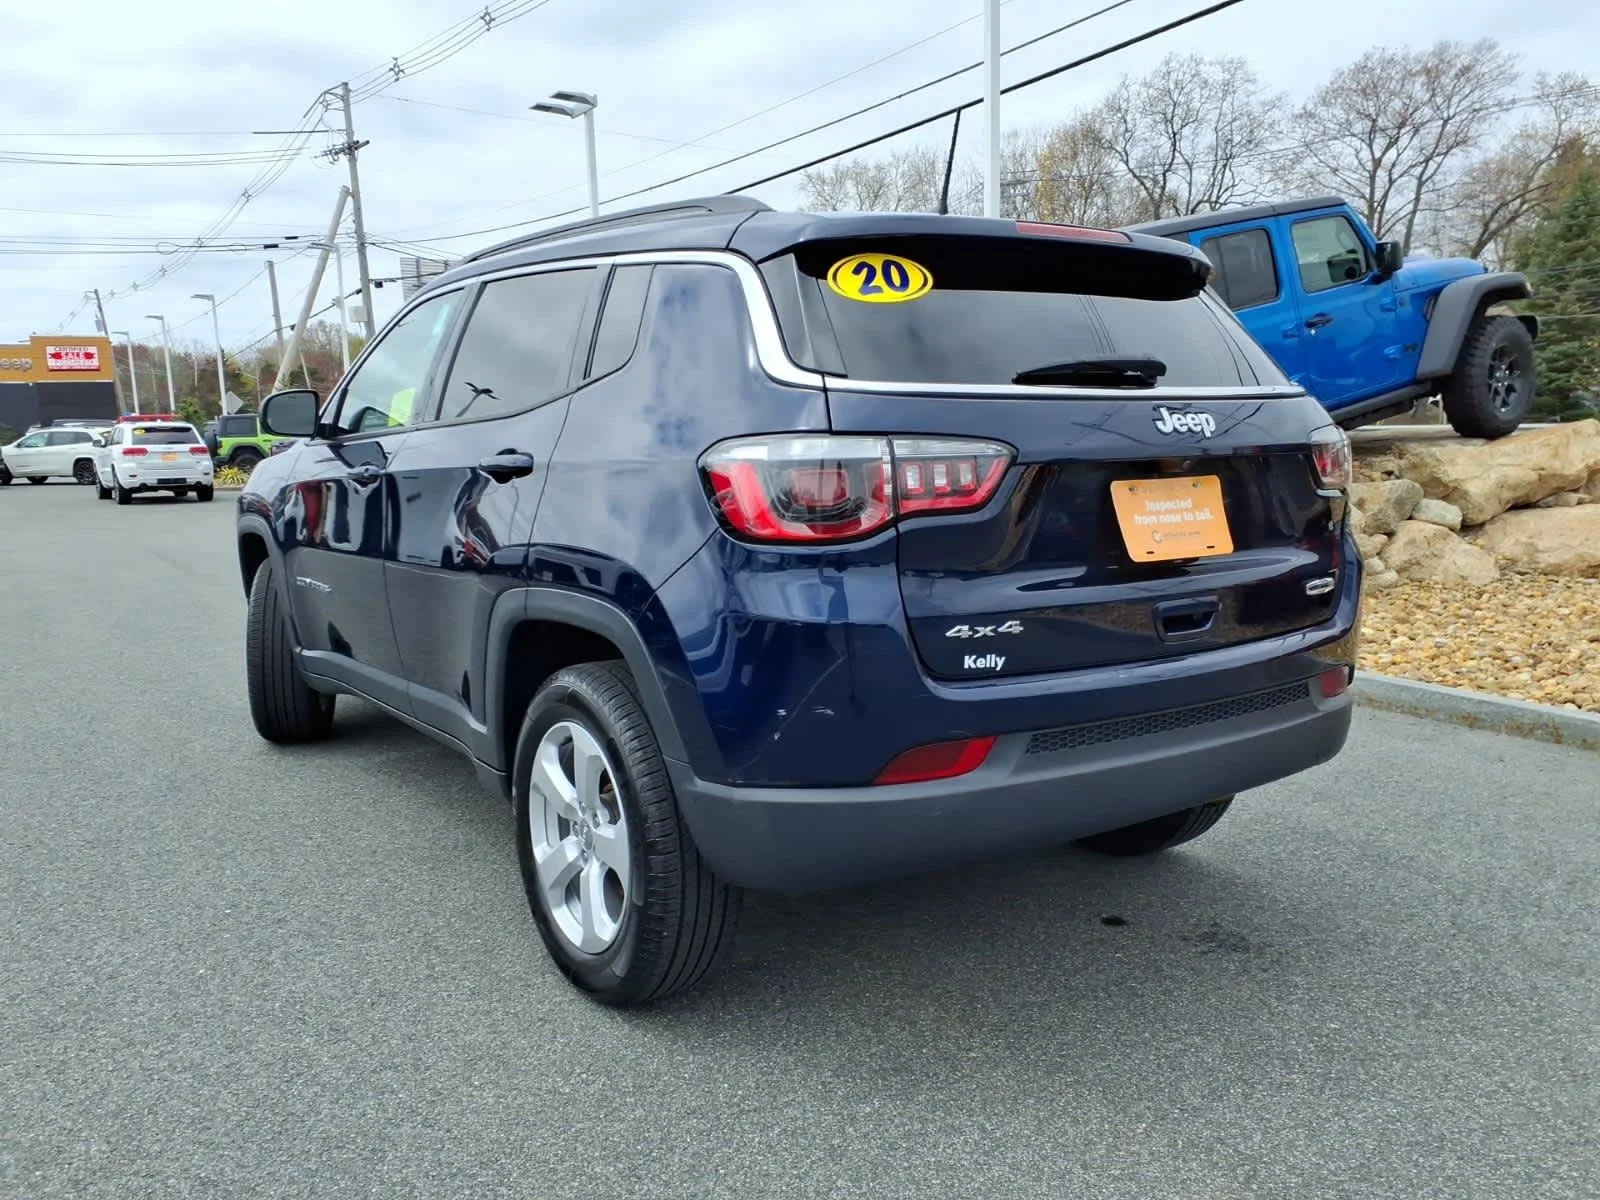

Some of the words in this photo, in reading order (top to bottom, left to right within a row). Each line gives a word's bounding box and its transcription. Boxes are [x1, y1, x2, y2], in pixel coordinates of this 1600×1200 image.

[851, 259, 910, 296] 20
[61, 352, 84, 360] SALE
[1154, 407, 1216, 438] Jeep
[1145, 498, 1192, 512] Inspected
[1134, 514, 1158, 525] from
[1159, 513, 1182, 523] nose
[1183, 511, 1195, 521] to
[945, 621, 1024, 638] 4x4
[963, 654, 1006, 671] Kelly
